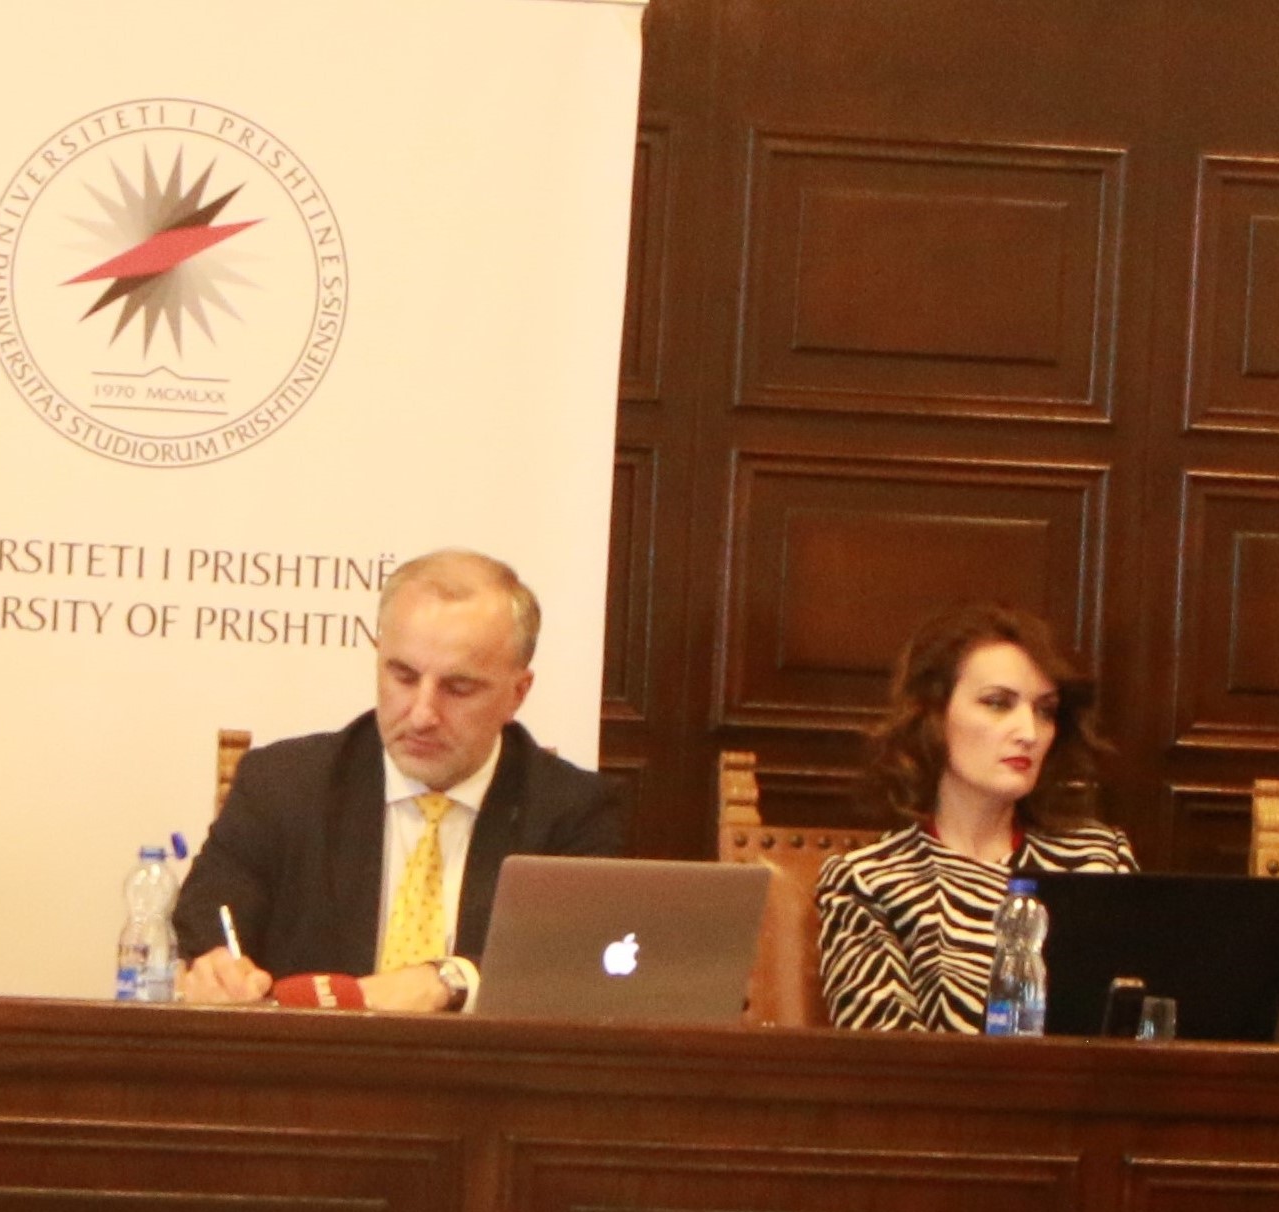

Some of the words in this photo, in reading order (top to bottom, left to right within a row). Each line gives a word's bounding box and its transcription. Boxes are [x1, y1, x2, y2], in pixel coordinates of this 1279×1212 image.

[188, 107, 196, 128] I
[93, 384, 136, 399] 1970
[66, 415, 220, 463] STUDIORUM
[162, 547, 170, 581] I
[126, 602, 180, 639] OF
[194, 606, 381, 649] PRISHTIN
